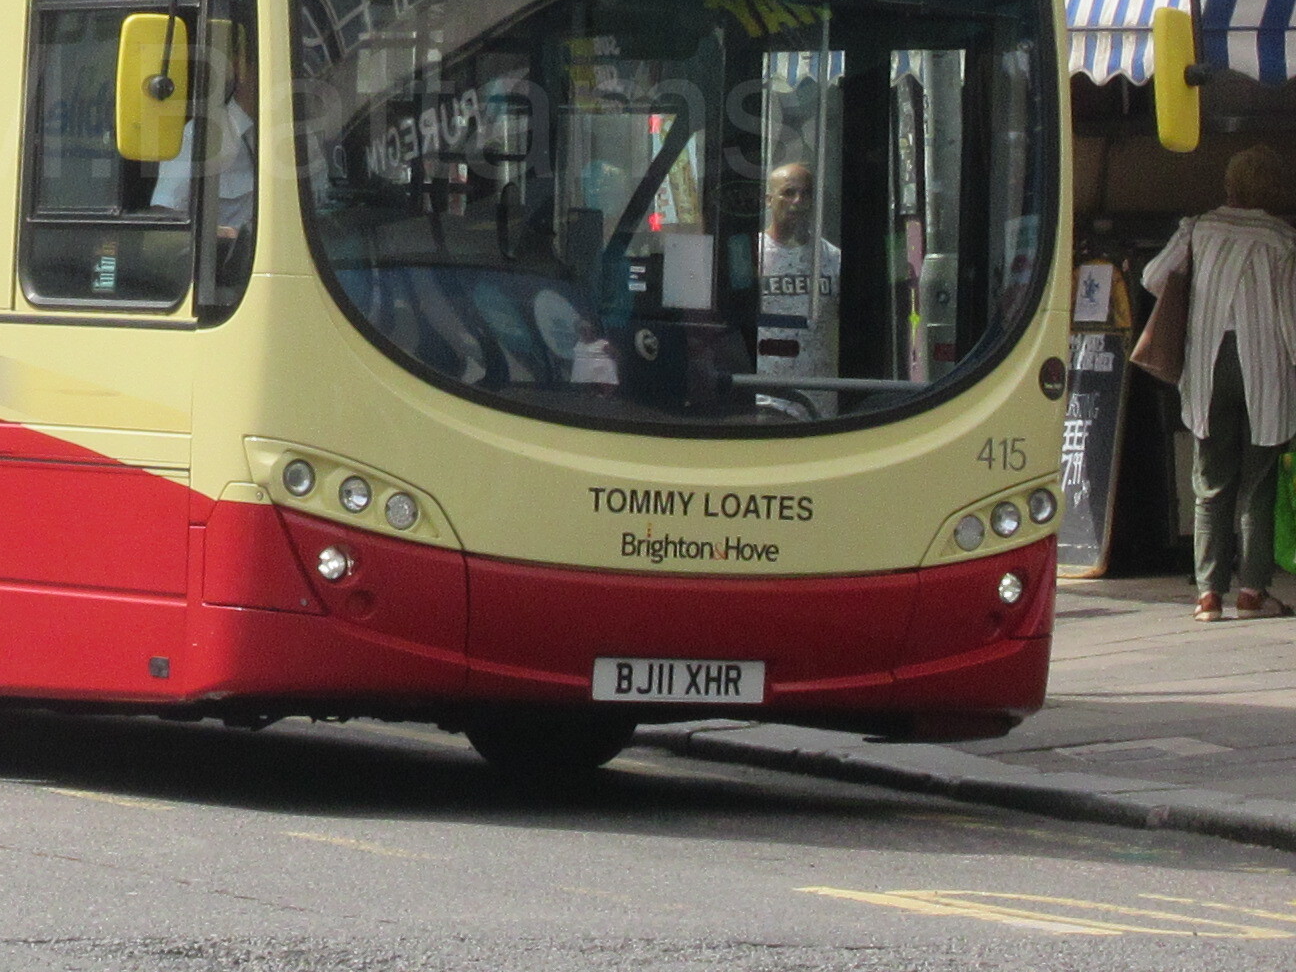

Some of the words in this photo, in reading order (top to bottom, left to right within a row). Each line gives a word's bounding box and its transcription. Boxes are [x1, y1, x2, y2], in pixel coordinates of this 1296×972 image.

[977, 436, 1027, 471] 415
[588, 487, 695, 517] TOMMY
[704, 491, 815, 522] LOATES
[615, 660, 674, 696] BJ11
[684, 662, 743, 697] XHR
